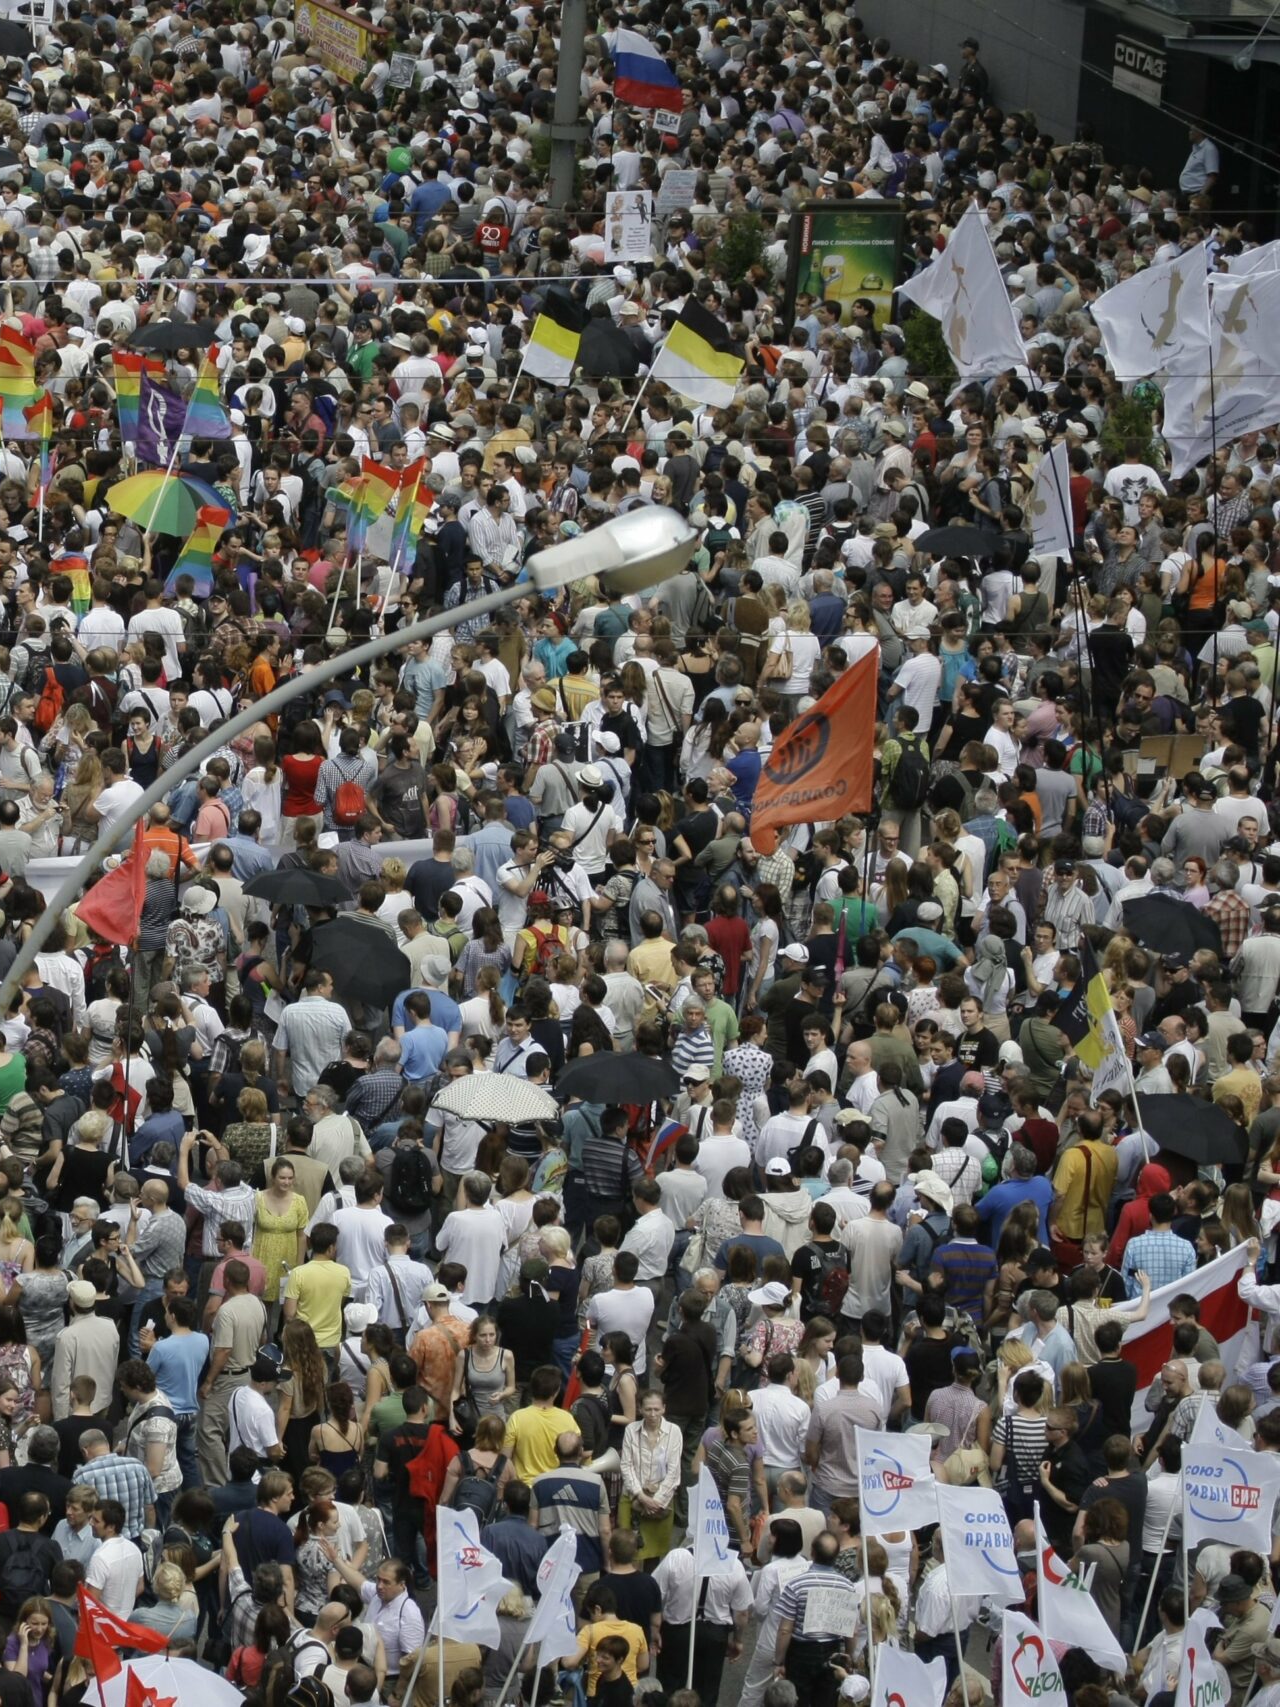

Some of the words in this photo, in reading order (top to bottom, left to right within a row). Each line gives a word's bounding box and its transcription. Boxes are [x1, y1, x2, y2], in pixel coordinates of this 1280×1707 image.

[1115, 43, 1166, 78] СОГАЗ
[482, 226, 500, 239] 90
[1186, 1465, 1224, 1478] СОЮЗ
[1232, 1487, 1258, 1506] СИЛ
[964, 1513, 1006, 1524] СОЮЗ
[965, 1532, 1013, 1549] ПРАВЫ
